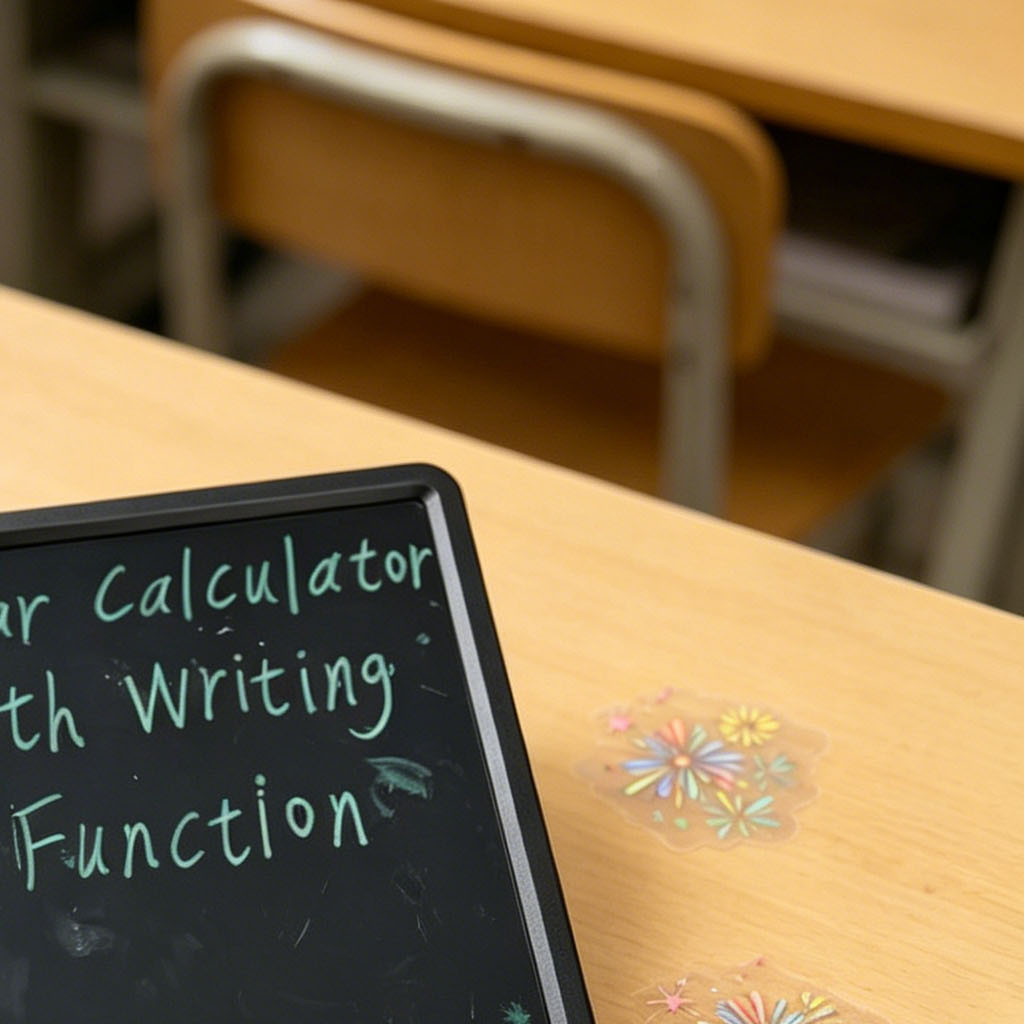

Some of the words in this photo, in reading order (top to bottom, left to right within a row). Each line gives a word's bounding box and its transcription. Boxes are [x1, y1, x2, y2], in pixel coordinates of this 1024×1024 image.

[93, 534, 433, 622] Calculator
[123, 650, 396, 741] Writing
[11, 774, 369, 892] Function
